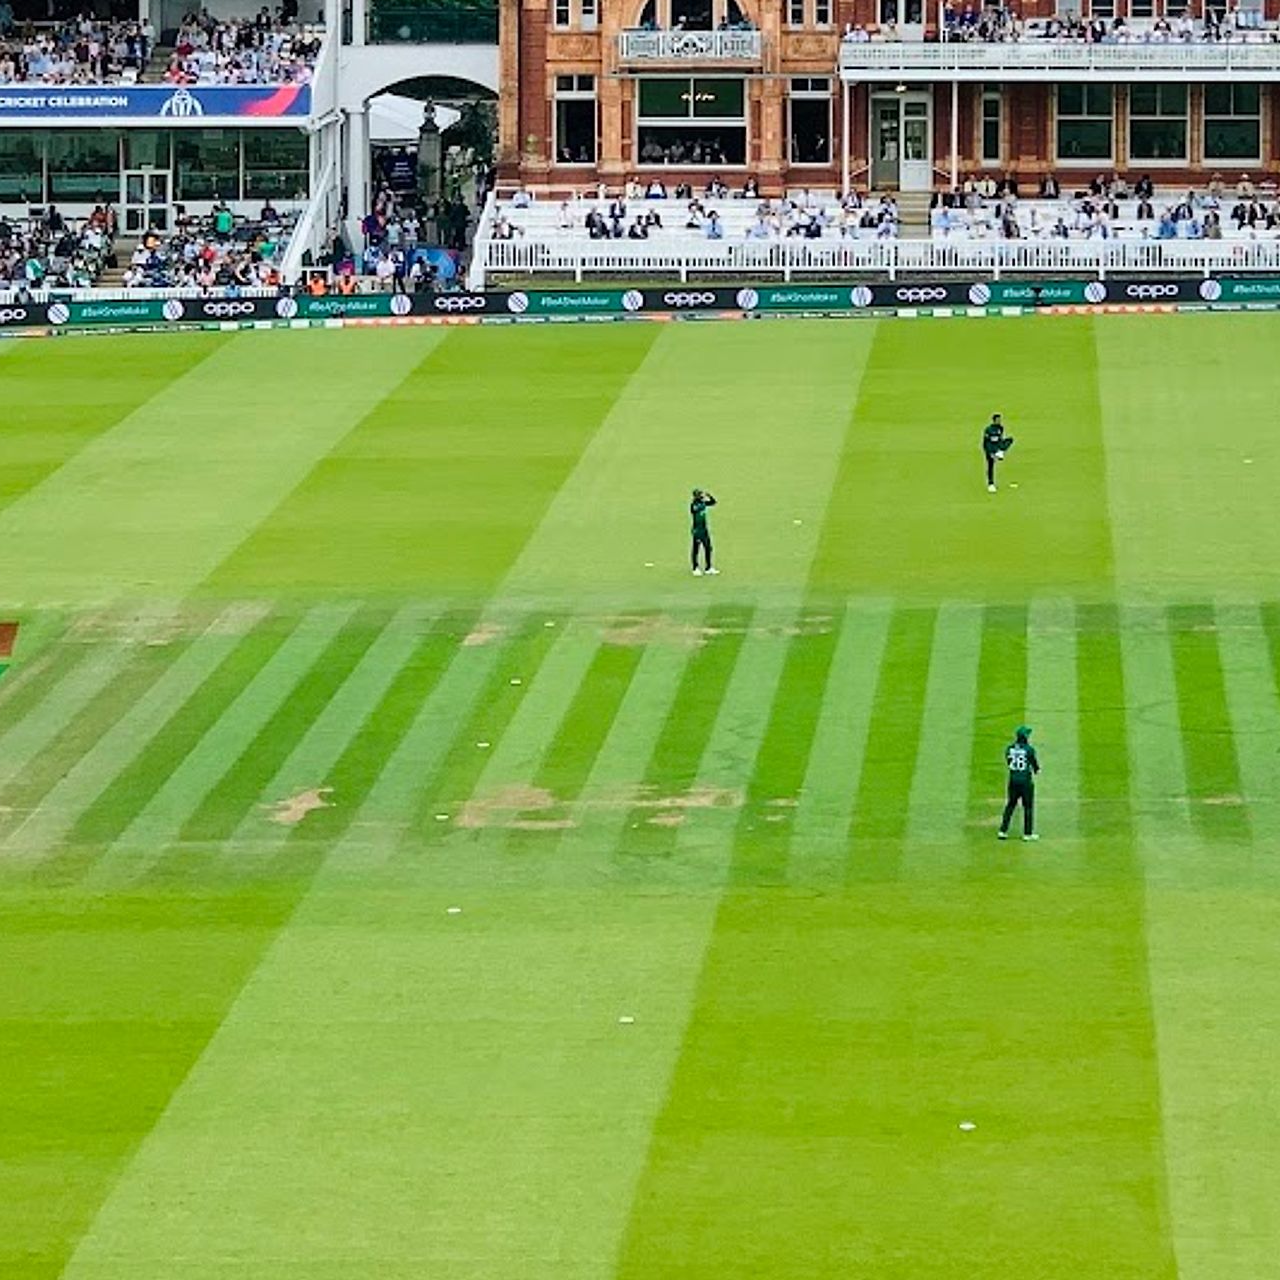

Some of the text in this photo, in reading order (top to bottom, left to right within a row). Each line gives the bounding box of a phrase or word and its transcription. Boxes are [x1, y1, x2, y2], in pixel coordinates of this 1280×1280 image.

[48, 96, 128, 107] CELEBRATION
[895, 287, 947, 302] oppo
[1126, 284, 1179, 298] oppo
[434, 296, 486, 311] oppo
[663, 291, 715, 307] oppo
[203, 302, 255, 317] oppo
